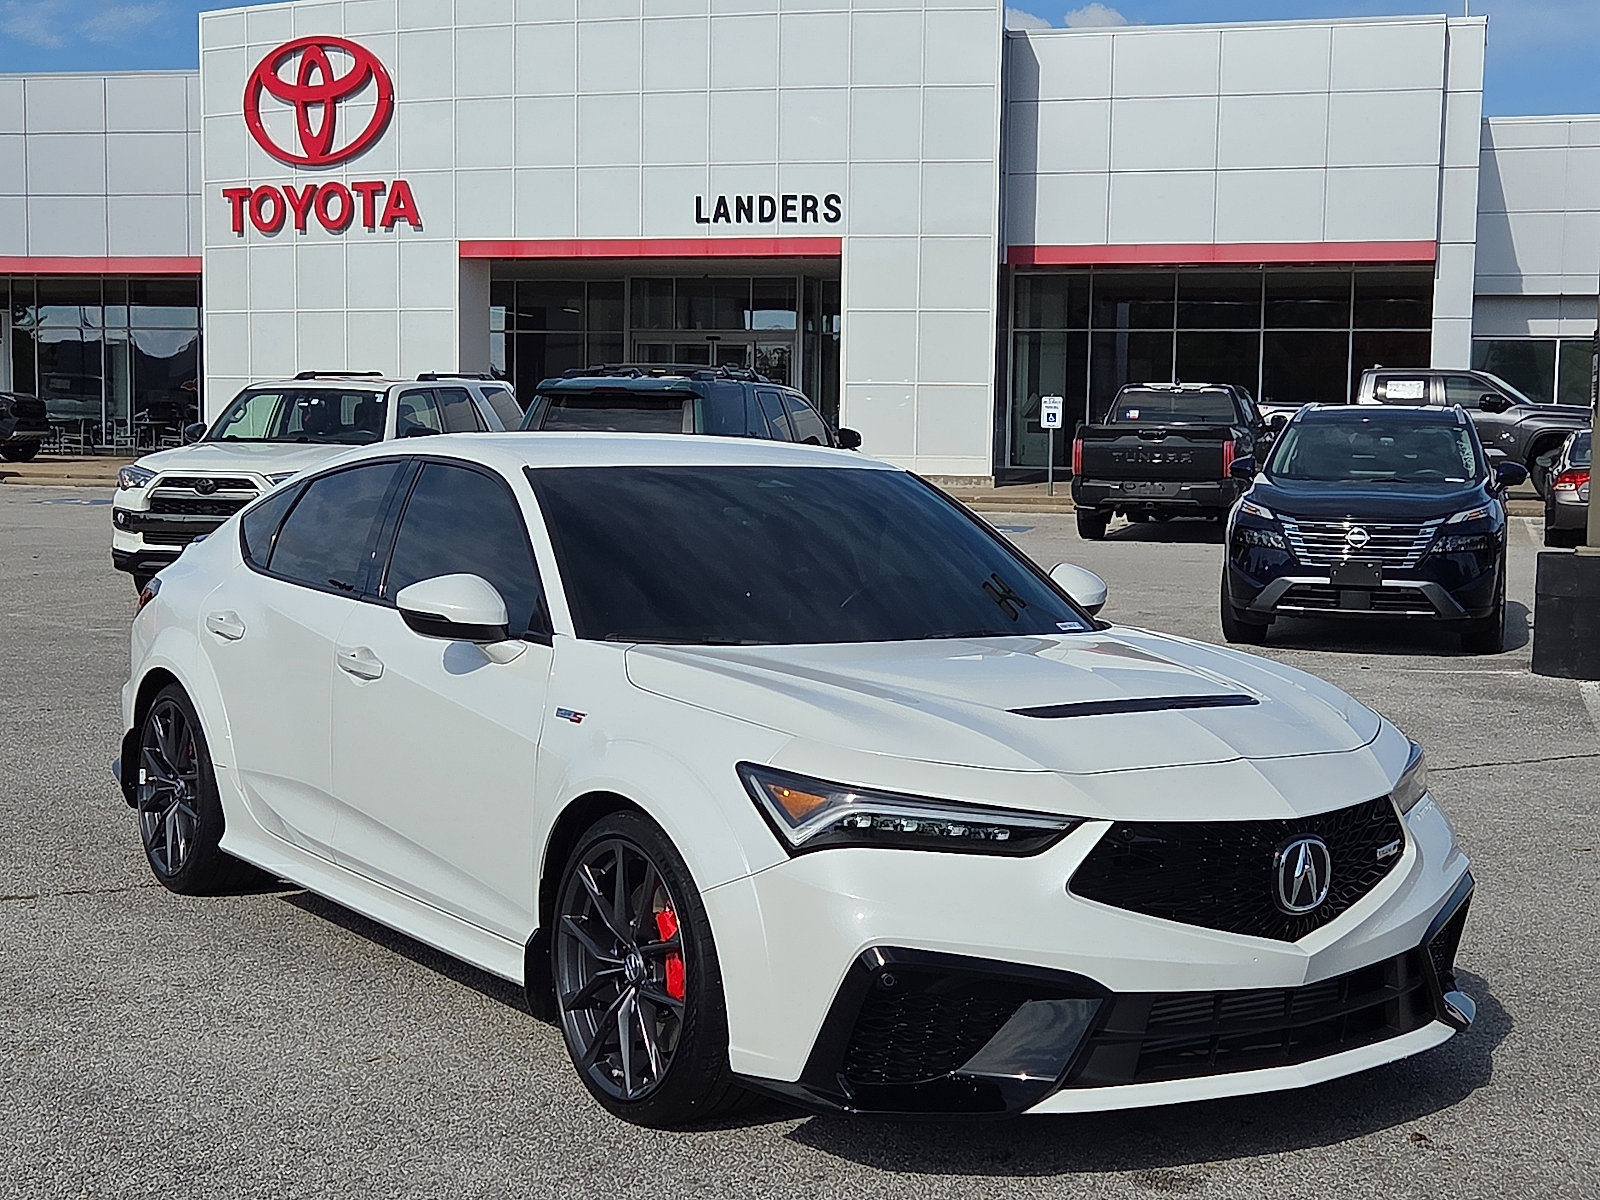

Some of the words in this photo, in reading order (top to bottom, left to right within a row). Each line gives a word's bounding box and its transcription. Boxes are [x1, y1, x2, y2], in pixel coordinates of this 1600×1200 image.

[222, 180, 422, 236] TOYOTA
[695, 194, 842, 223] LANDERS
[1112, 451, 1193, 463] TUNDRA
